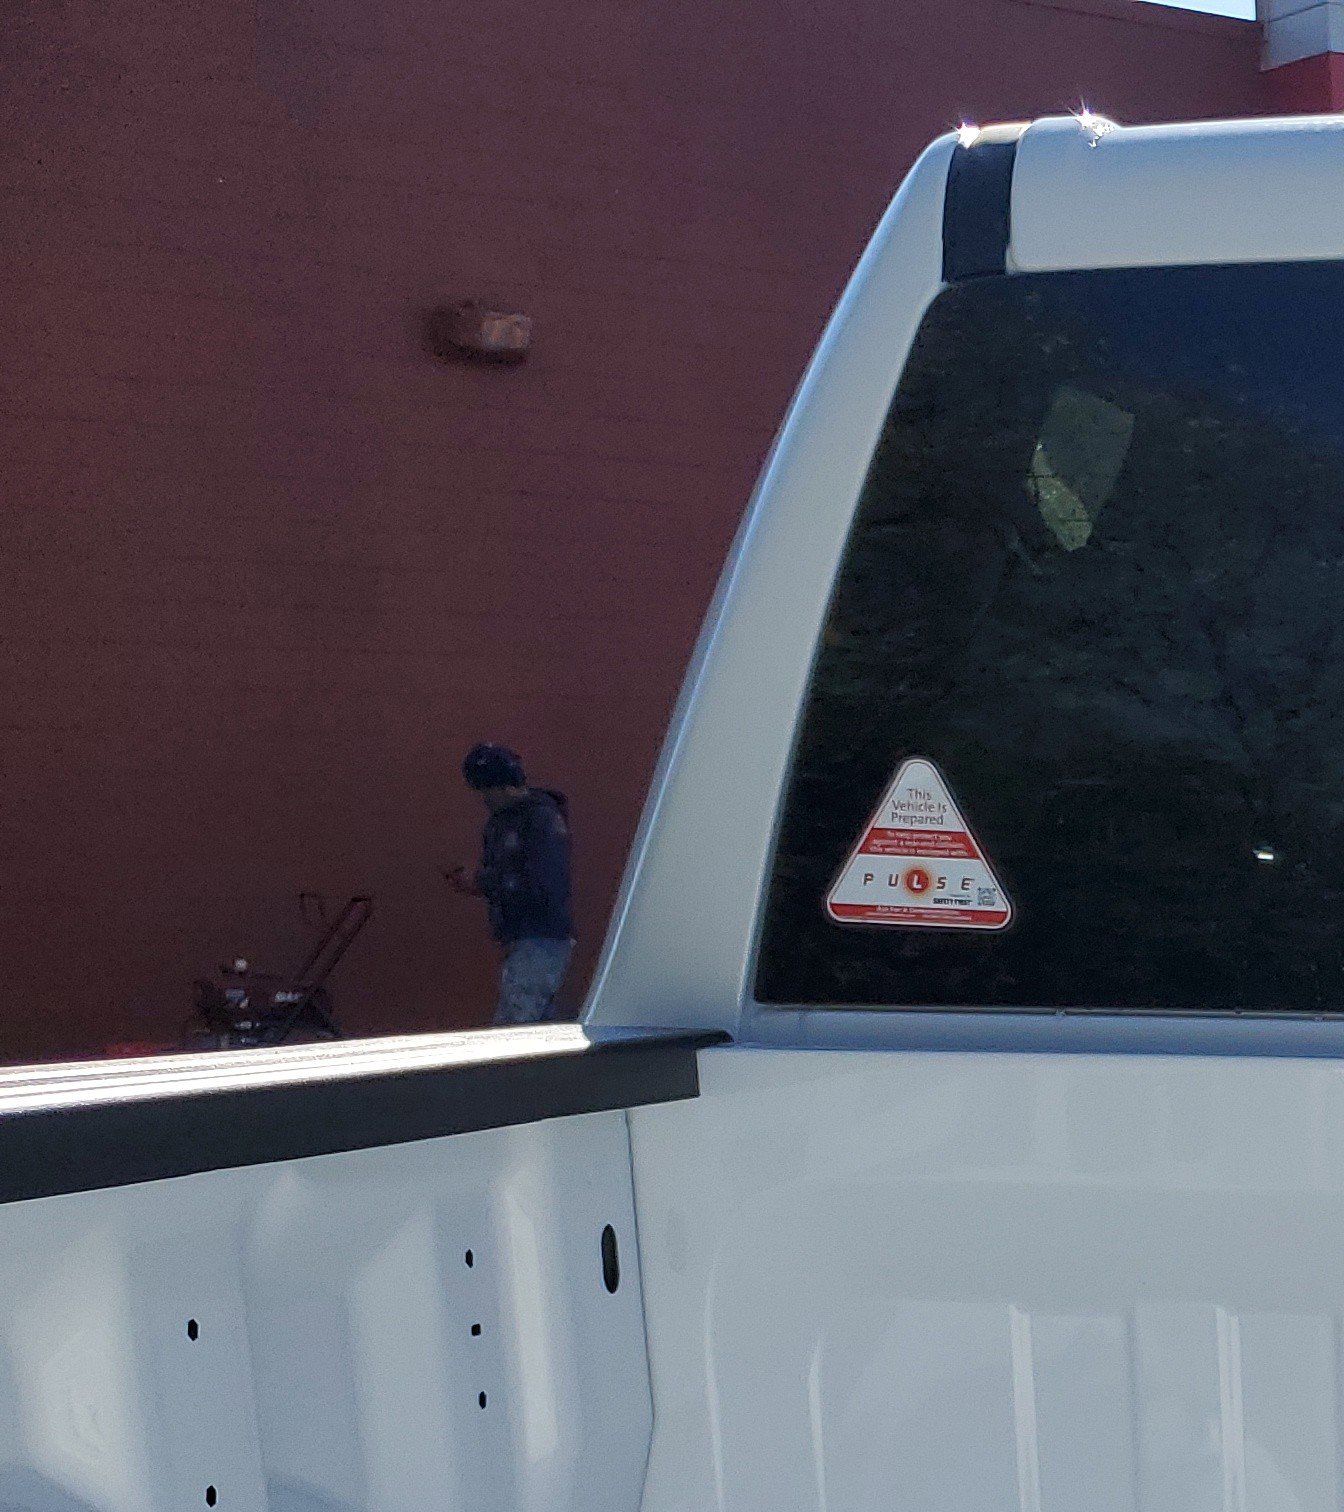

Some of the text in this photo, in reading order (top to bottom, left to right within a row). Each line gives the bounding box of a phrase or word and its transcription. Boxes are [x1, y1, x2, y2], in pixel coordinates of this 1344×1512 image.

[906, 788, 932, 801] This
[891, 799, 935, 813] Vehicle
[891, 811, 944, 827] Prepared
[863, 873, 974, 891] PULSE
